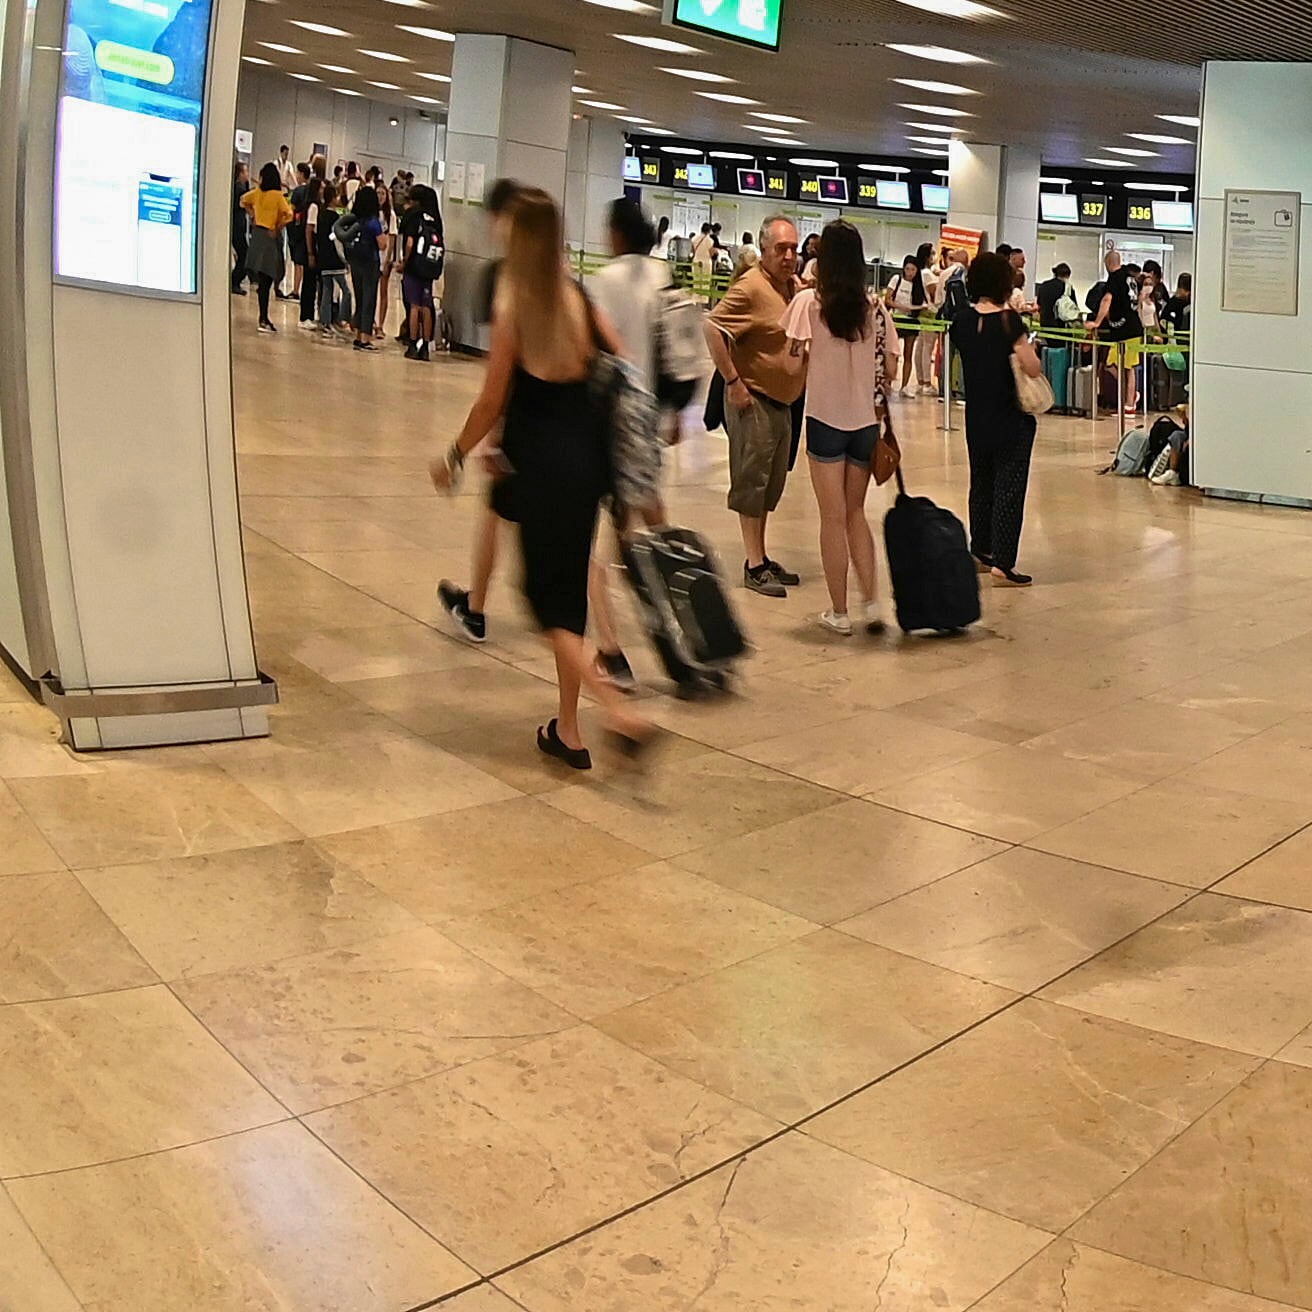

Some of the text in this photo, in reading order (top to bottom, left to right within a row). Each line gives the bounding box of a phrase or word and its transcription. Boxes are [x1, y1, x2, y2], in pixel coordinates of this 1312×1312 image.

[643, 162, 658, 177] 343
[673, 167, 689, 181] 342
[768, 176, 784, 191] 341
[800, 179, 818, 193] 340
[859, 184, 876, 198] 339
[1083, 203, 1103, 215] 337
[1129, 207, 1150, 219] 336
